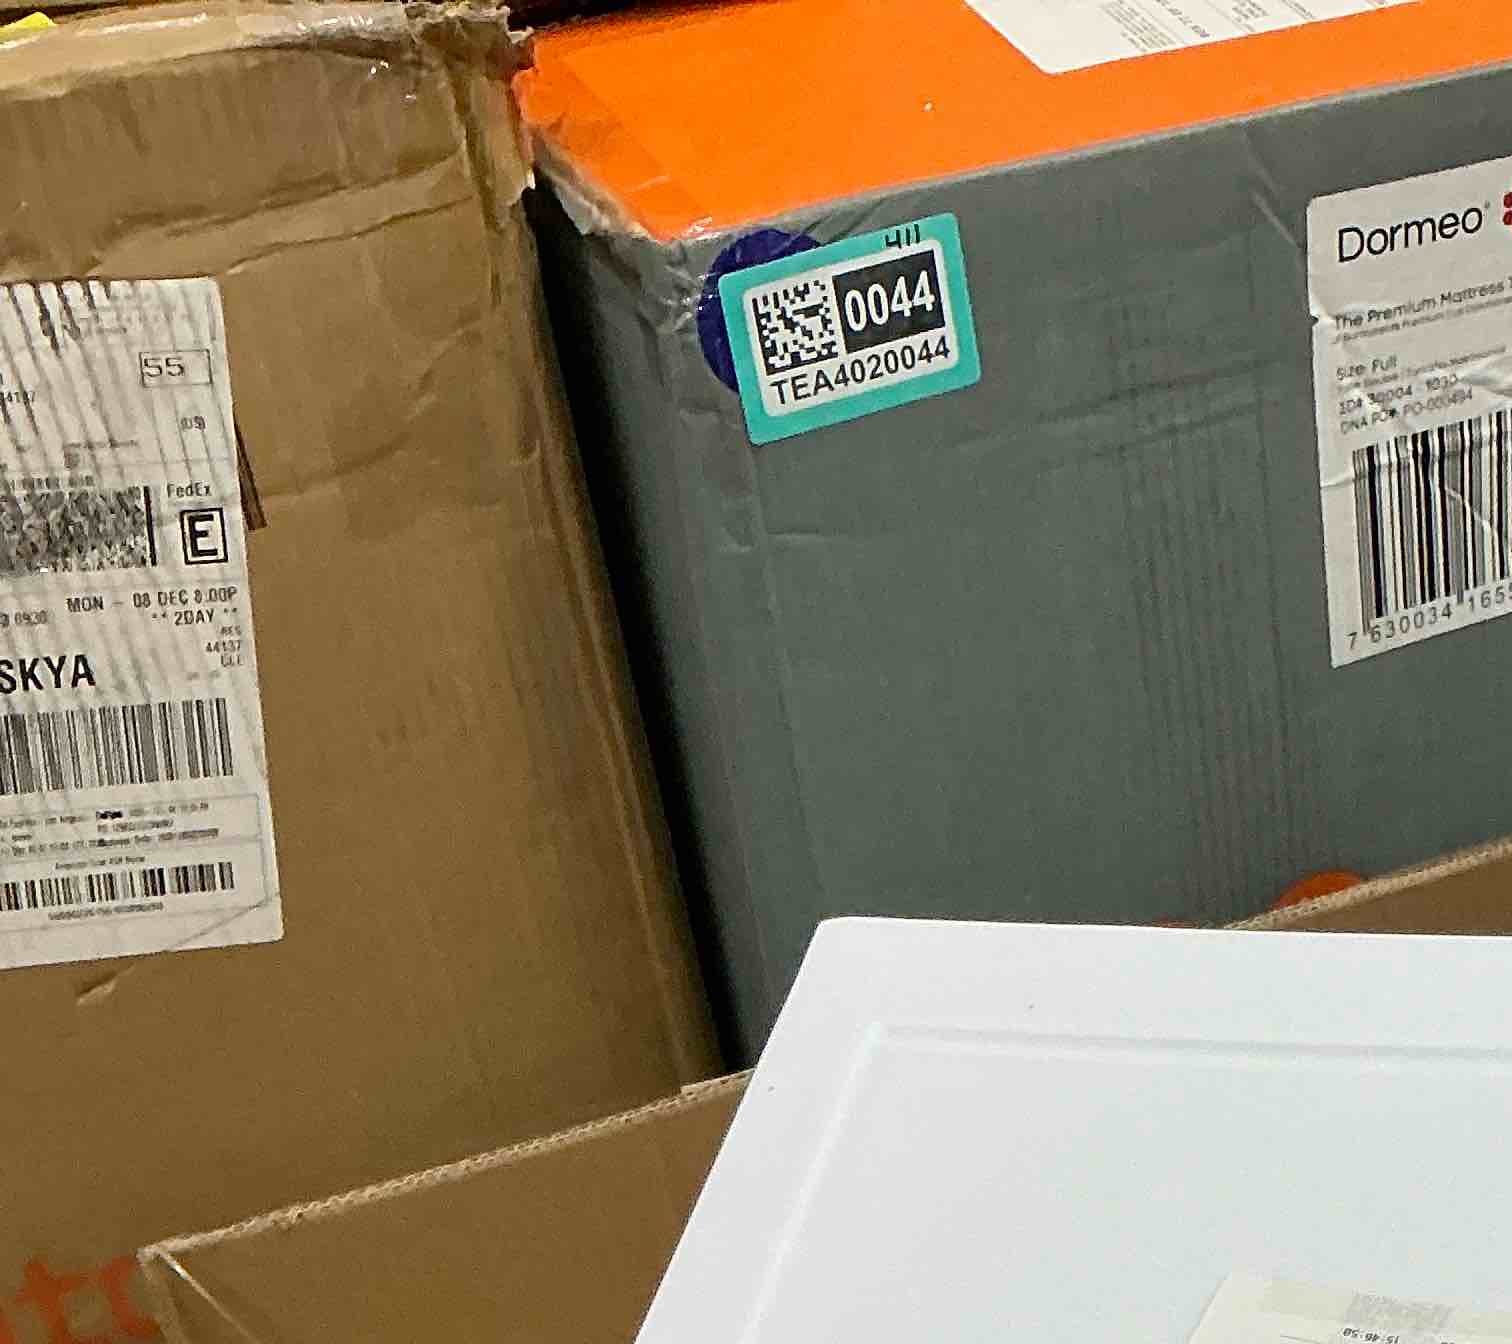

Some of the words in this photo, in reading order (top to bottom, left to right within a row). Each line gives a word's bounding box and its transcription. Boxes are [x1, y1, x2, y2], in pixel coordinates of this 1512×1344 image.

[1338, 206, 1483, 263] Dormeo
[844, 269, 936, 332] 0044
[1335, 313, 1364, 330] The
[1367, 297, 1437, 322] Premium
[1440, 281, 1505, 304] Mattress
[143, 357, 186, 378] 55
[768, 336, 950, 405] TEA4020044
[166, 482, 212, 500] FedEx
[189, 516, 217, 558] E
[66, 596, 105, 613] MON
[157, 589, 189, 607] DEC
[174, 608, 215, 627] 2DAY
[1346, 632, 1358, 650] 7
[1370, 603, 1453, 643] 630034
[0, 654, 96, 695] SKYA
